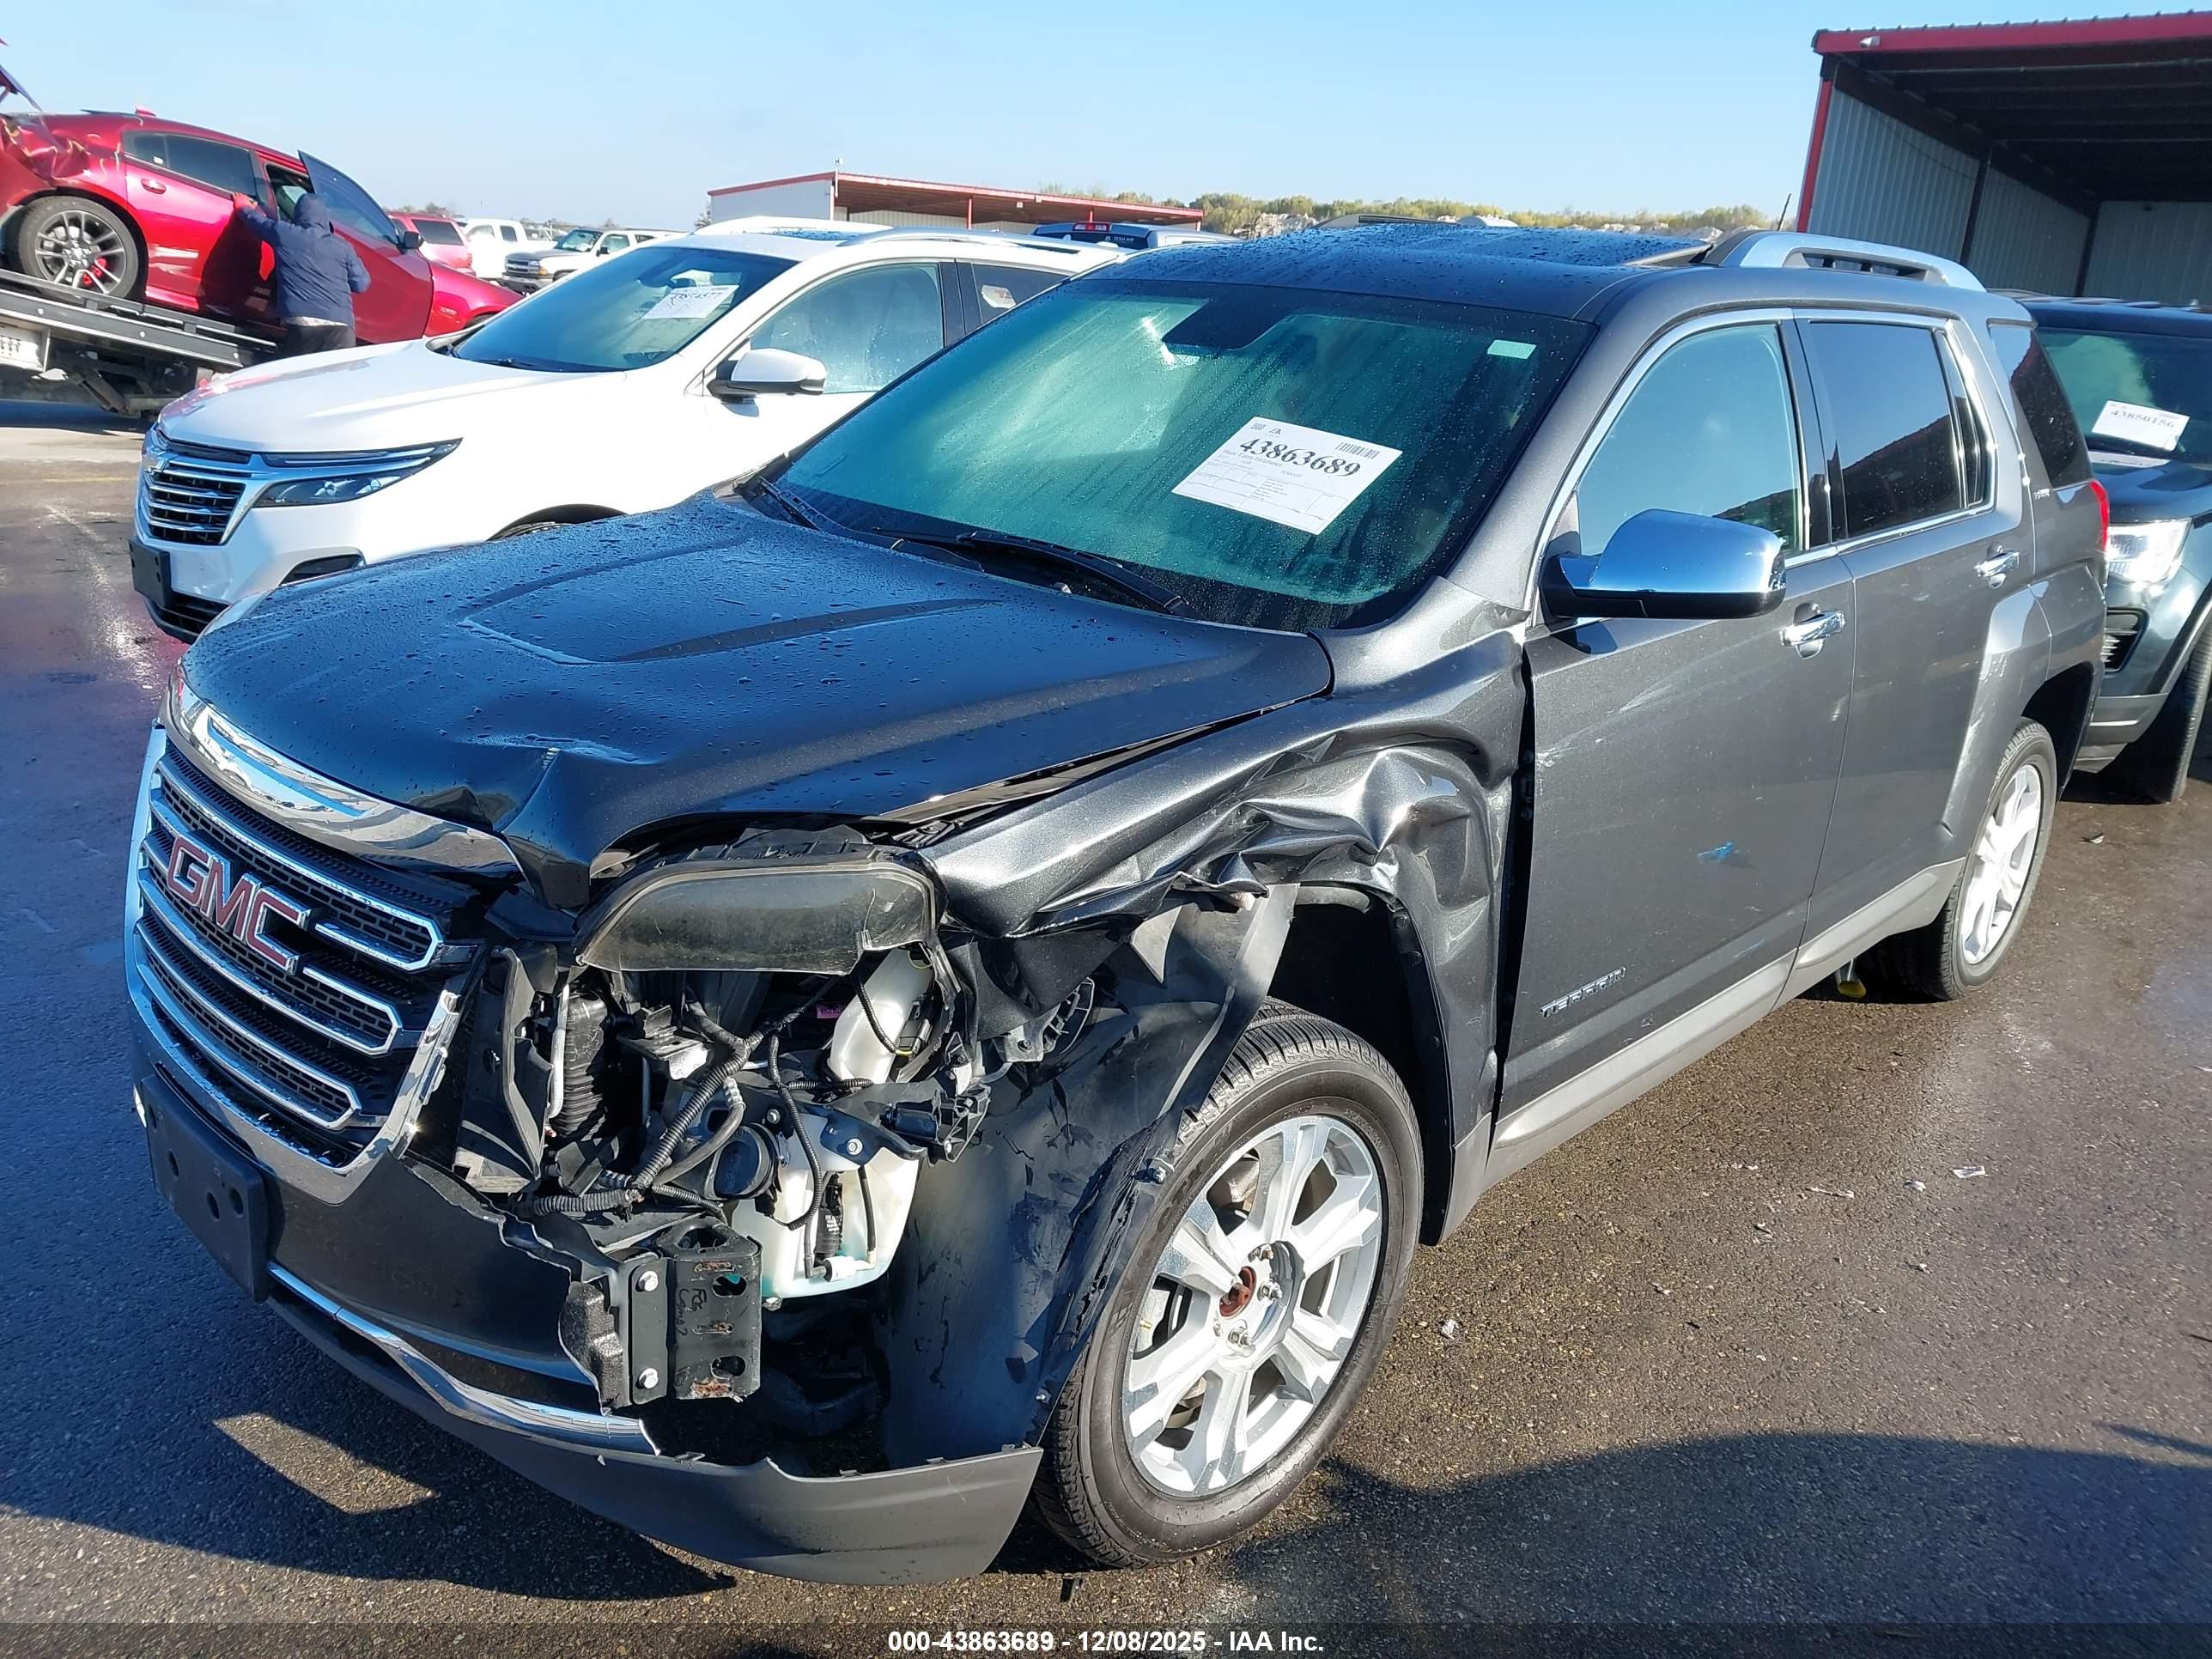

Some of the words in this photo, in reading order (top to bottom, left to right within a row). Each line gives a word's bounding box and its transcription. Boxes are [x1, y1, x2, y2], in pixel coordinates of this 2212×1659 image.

[1239, 438, 1362, 477] 43863689
[167, 835, 311, 975] GMC
[1539, 966, 1626, 1019] TERRAIN
